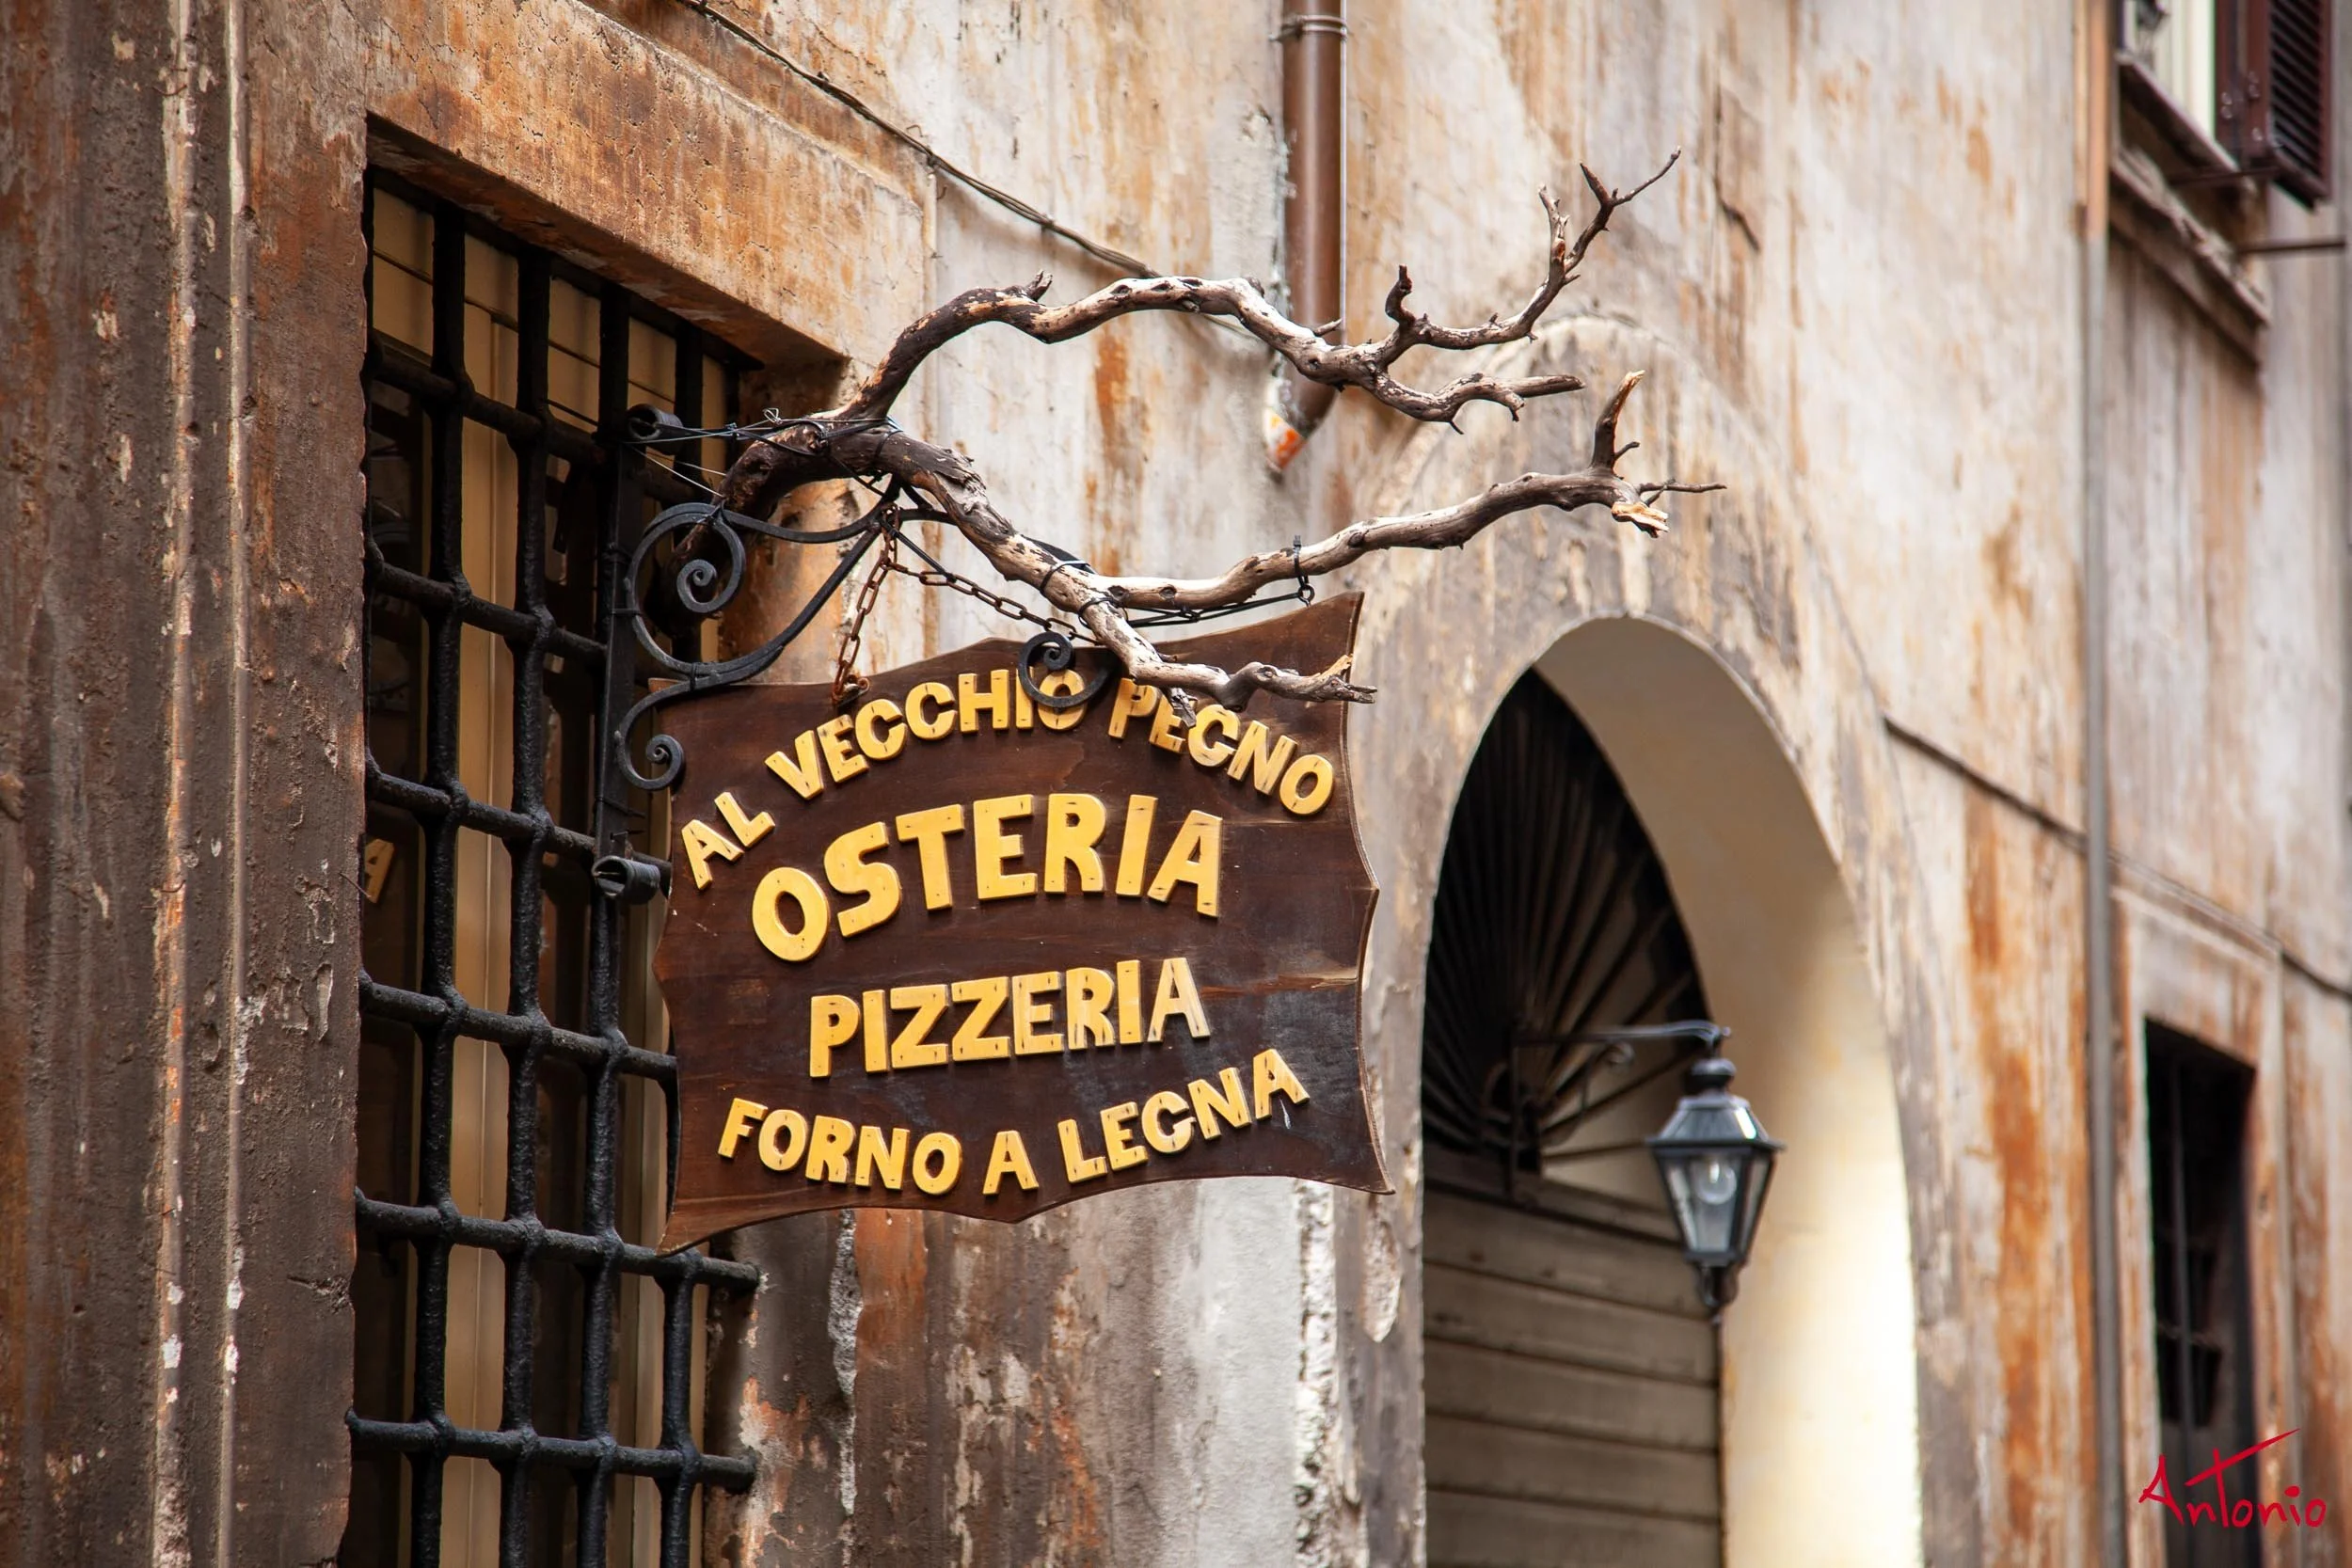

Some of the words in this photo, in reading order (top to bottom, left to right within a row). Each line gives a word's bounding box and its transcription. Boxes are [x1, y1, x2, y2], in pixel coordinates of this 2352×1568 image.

[680, 791, 776, 891] AL
[764, 668, 1089, 800] VECCHIO
[1107, 676, 1335, 816] PEGNO
[752, 792, 1224, 962] OSTERIA
[809, 957, 1211, 1079] PIZZERIA
[717, 1097, 963, 1196] FORNO
[981, 1130, 1040, 1196] A
[1057, 1048, 1311, 1183] LEGNA
